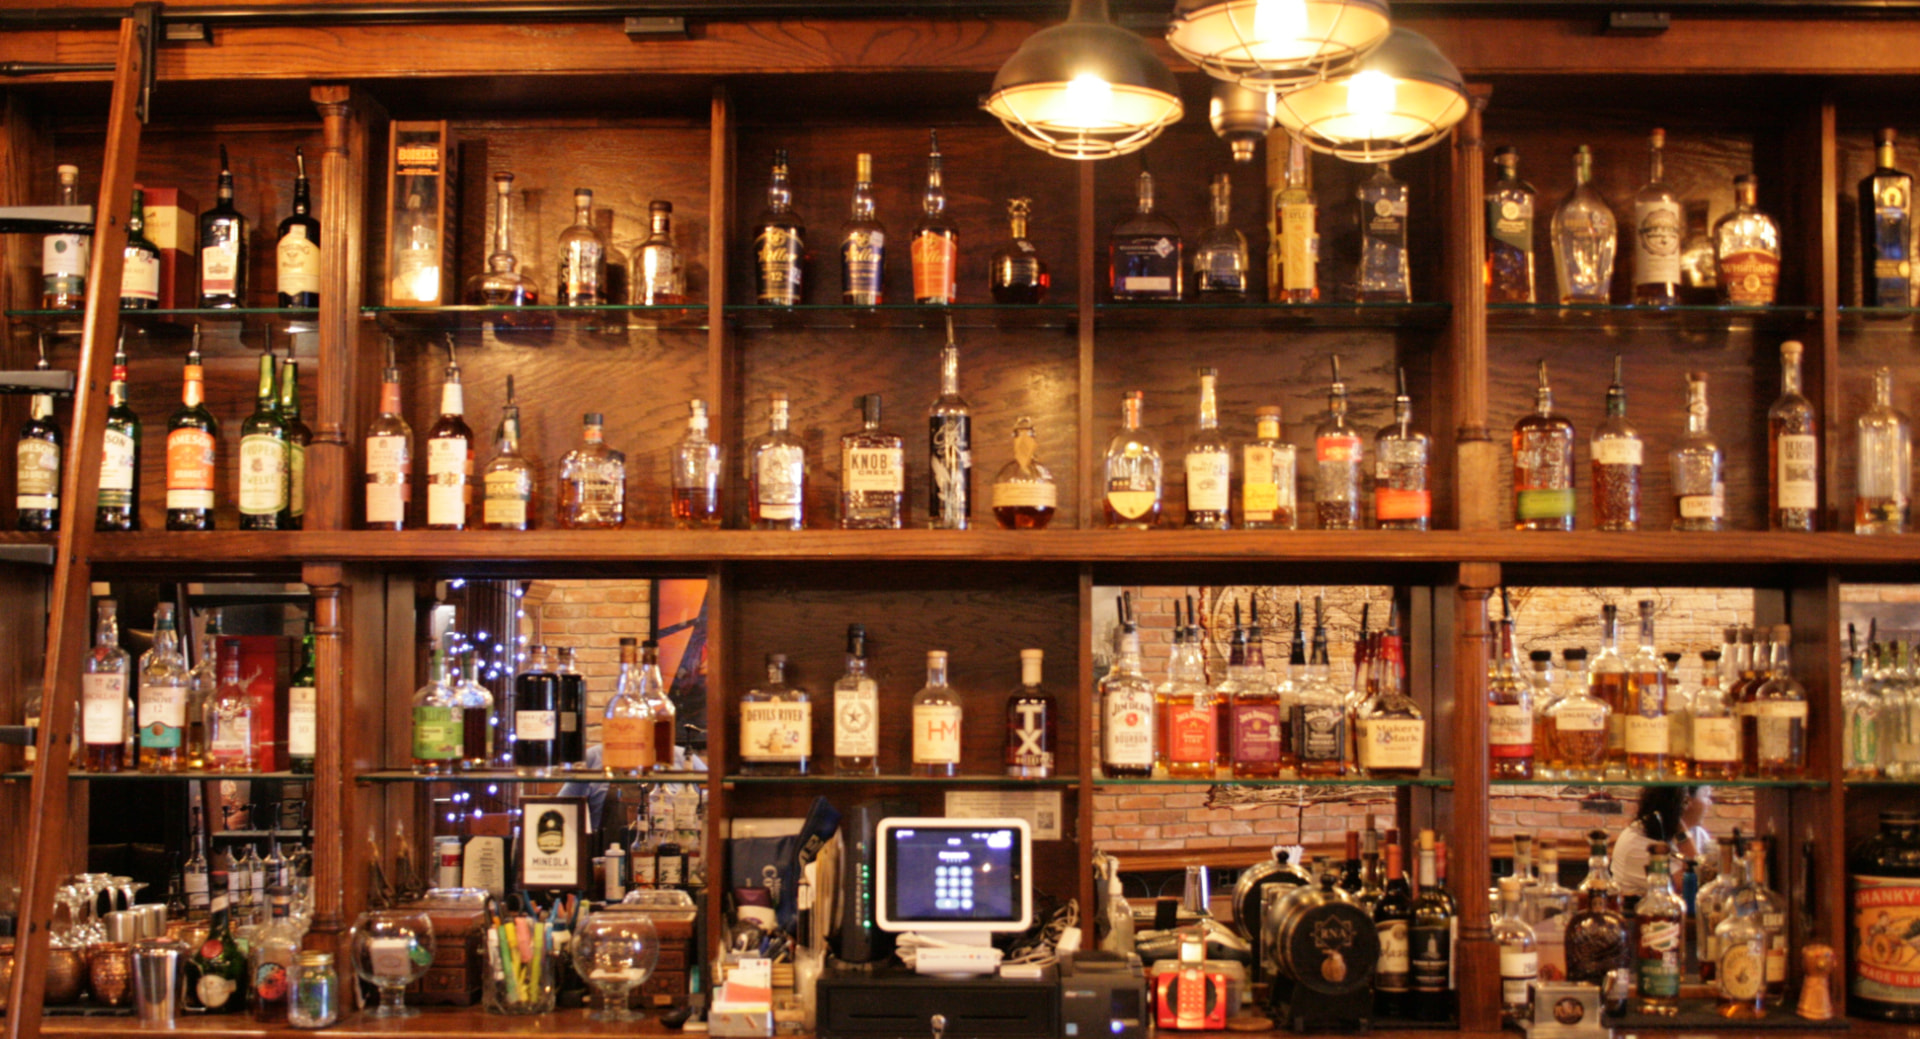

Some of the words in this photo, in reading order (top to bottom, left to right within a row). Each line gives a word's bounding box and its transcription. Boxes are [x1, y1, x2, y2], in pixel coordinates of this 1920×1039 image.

[18, 442, 57, 456] AMESON
[851, 453, 888, 470] KNOB
[746, 708, 776, 722] DEVILS
[778, 708, 804, 722] RIVER
[928, 720, 959, 741] HM
[1376, 723, 1420, 734] Maker's
[532, 856, 570, 867] MINEOLA
